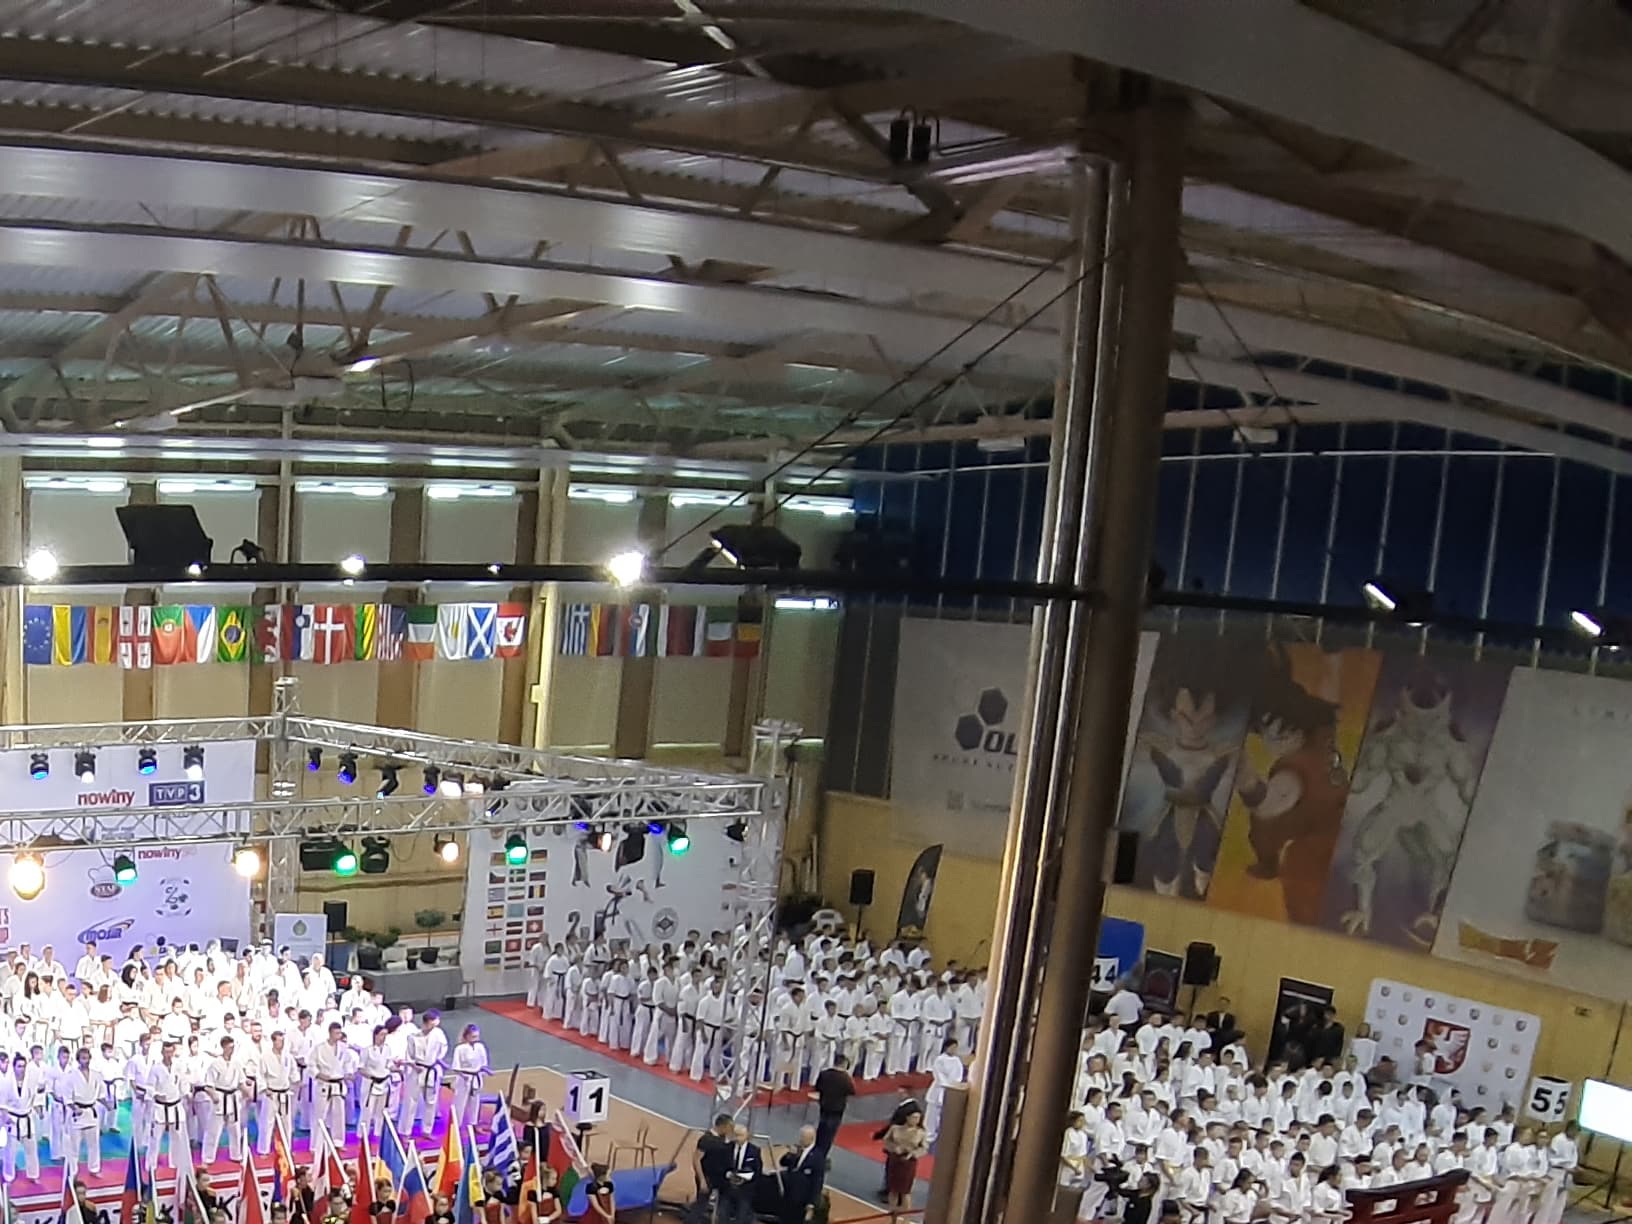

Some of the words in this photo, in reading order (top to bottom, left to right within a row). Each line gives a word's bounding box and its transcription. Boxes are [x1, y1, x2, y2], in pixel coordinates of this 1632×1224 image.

[78, 788, 135, 806] nowiny
[138, 846, 182, 859] nowiny
[570, 1086, 579, 1112] 1
[589, 1087, 604, 1113] 1
[1531, 1086, 1553, 1113] 5
